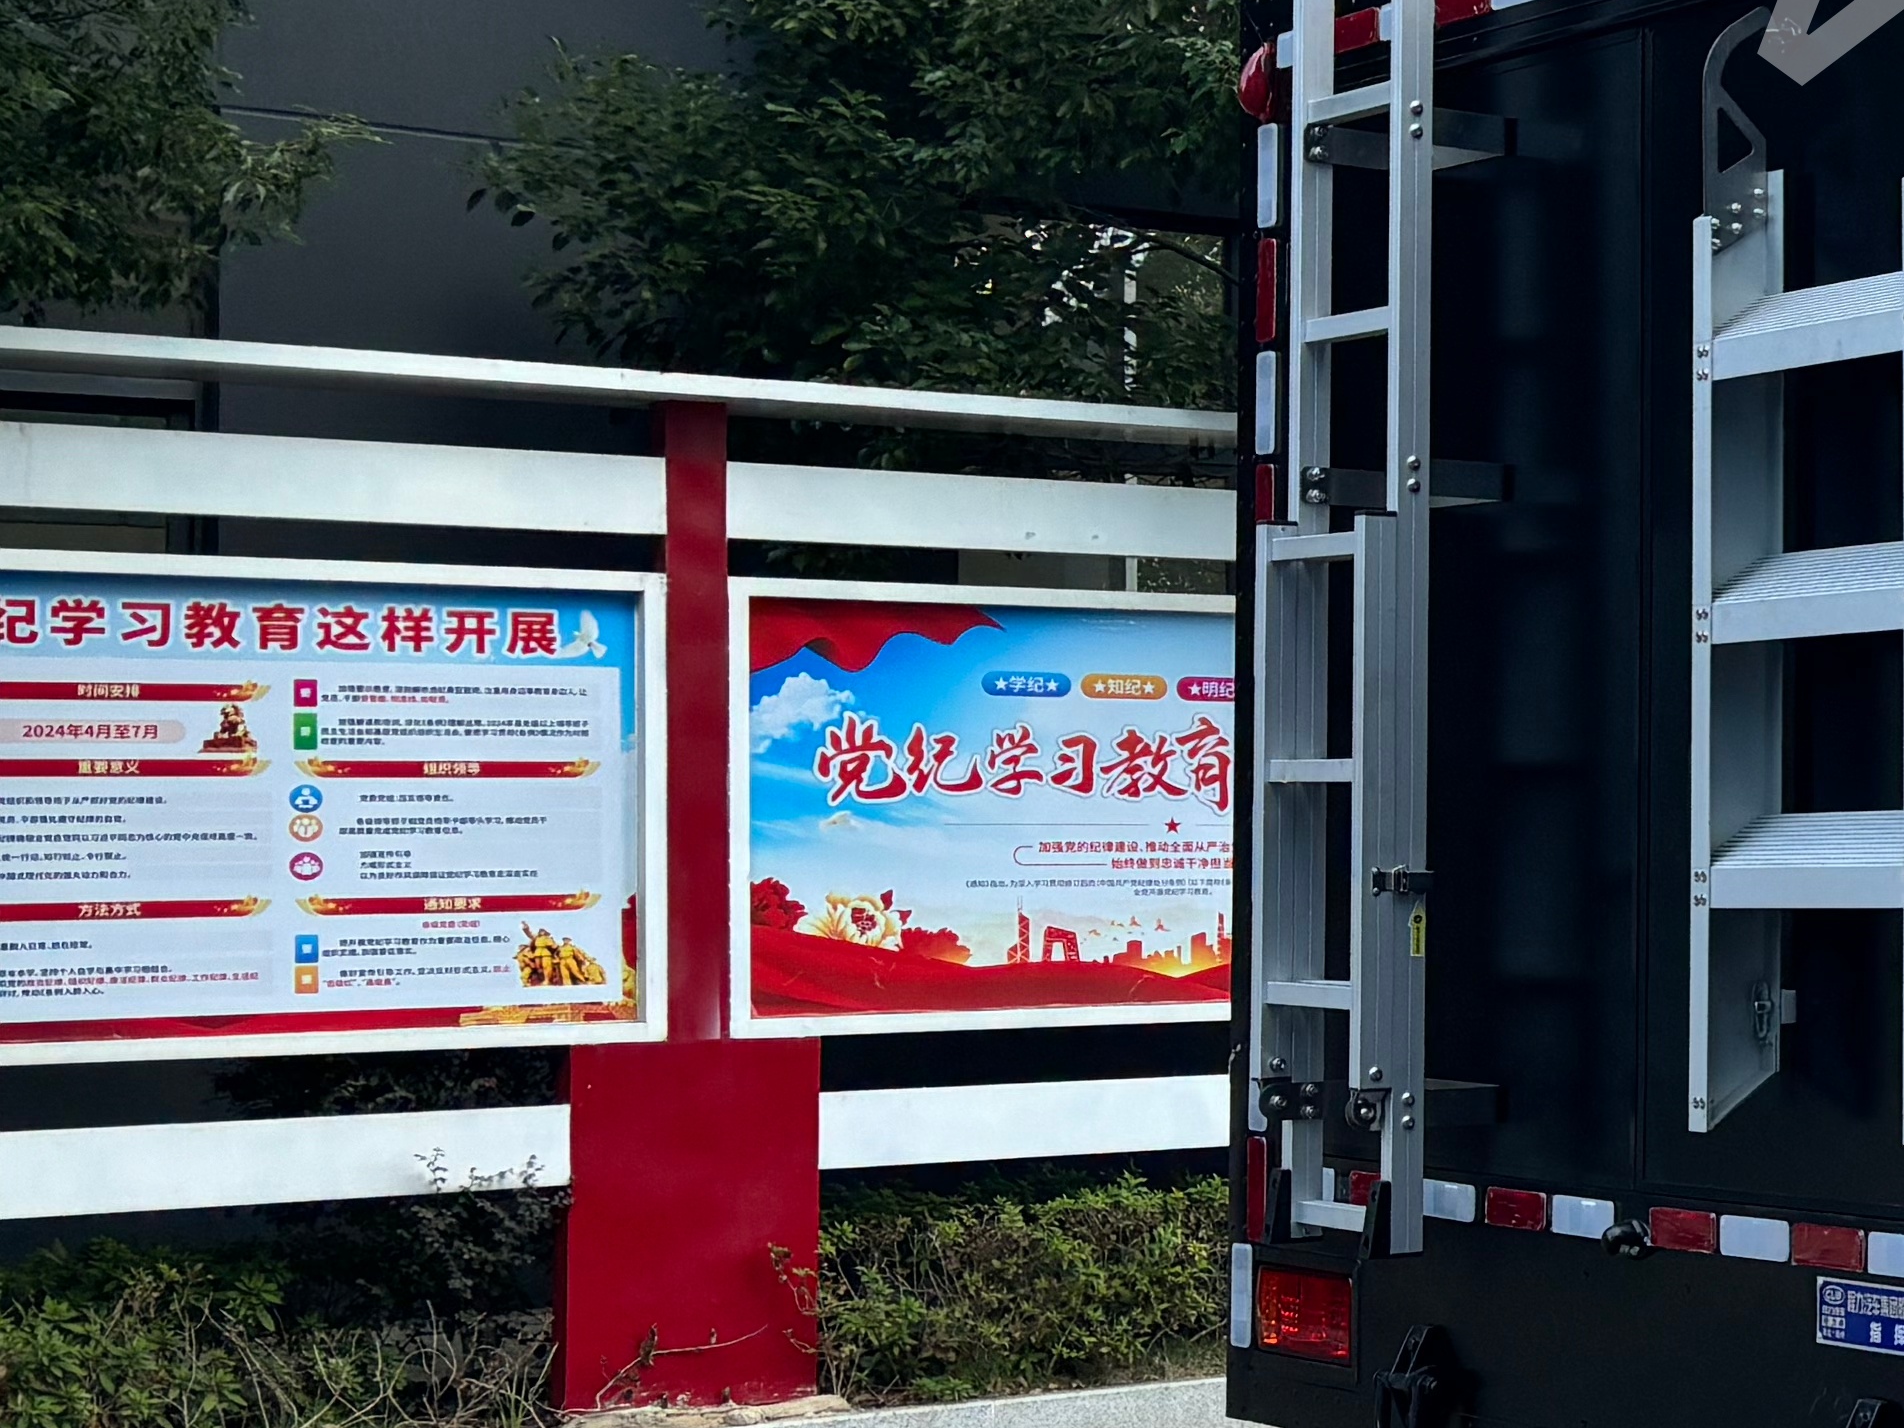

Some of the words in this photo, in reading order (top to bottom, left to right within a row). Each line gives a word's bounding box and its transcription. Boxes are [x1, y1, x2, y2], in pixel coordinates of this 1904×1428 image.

[77, 683, 140, 698] 时间安排
[22, 723, 158, 740] 2024年4月至7月
[77, 759, 141, 774] 重要意义
[817, 713, 1232, 812] 党纪学习教育
[1038, 841, 1234, 854] 加强党的纪律建设、推动全面从严治
[77, 902, 141, 917] 方法方式
[423, 897, 482, 911] 通知要求
